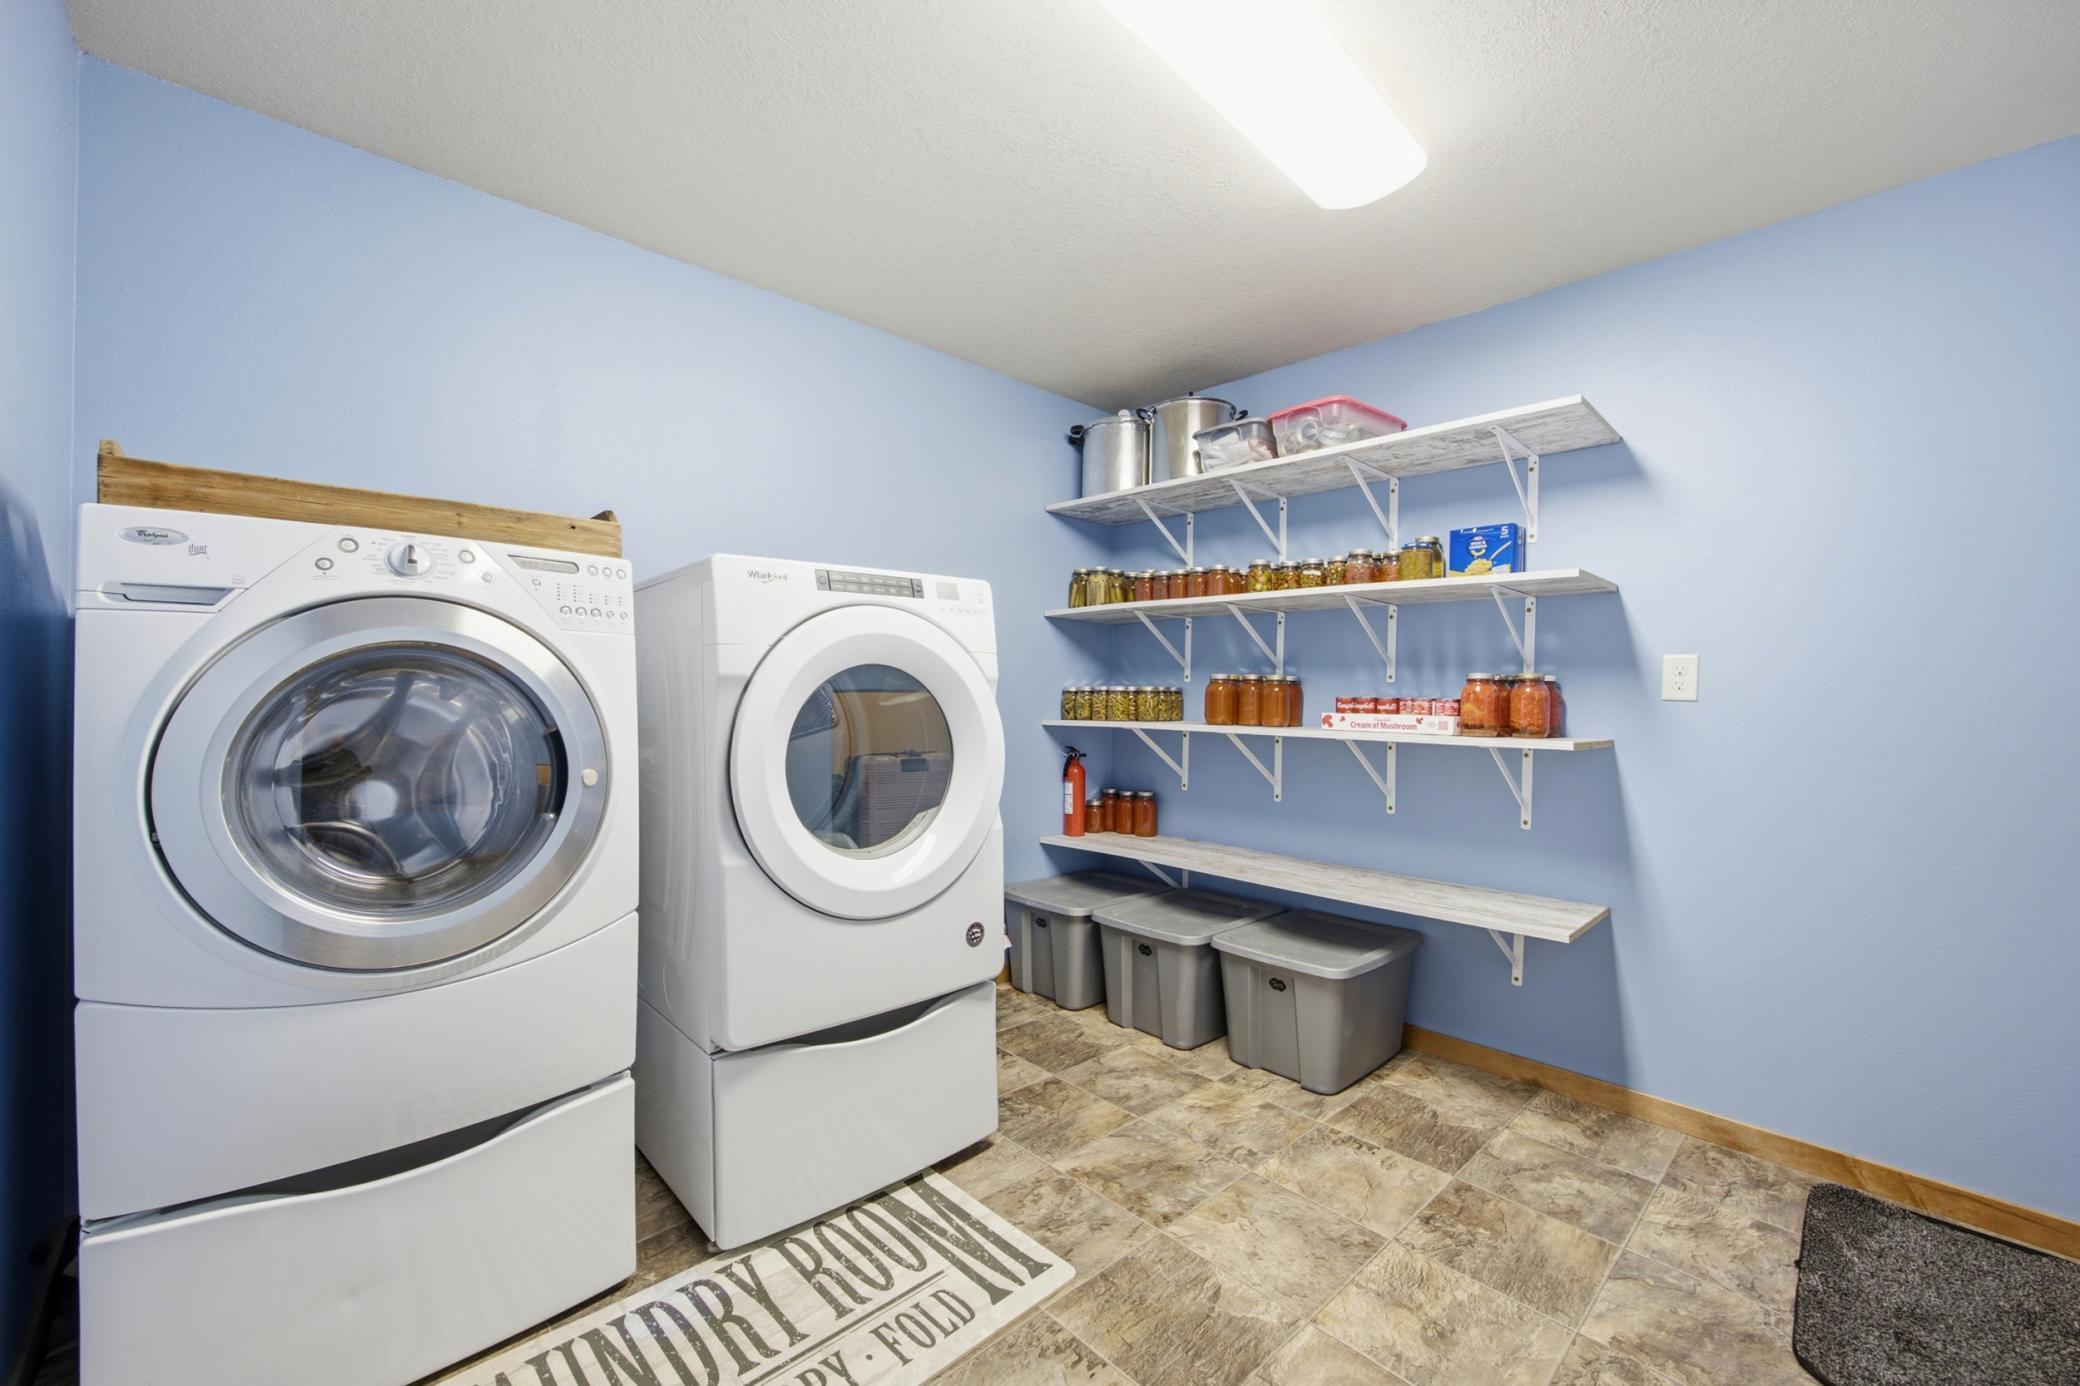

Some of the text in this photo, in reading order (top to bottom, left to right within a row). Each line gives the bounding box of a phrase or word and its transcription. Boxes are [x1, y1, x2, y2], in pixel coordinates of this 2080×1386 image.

[136, 529, 169, 538] Whirlpool
[1500, 525, 1509, 535] 5
[1350, 720, 1372, 729] Cream
[1373, 721, 1380, 729] of
[1380, 722, 1418, 730] Mushroom
[473, 1173, 1053, 1386] NDRY ROOM
[867, 1288, 976, 1367] FOLD
